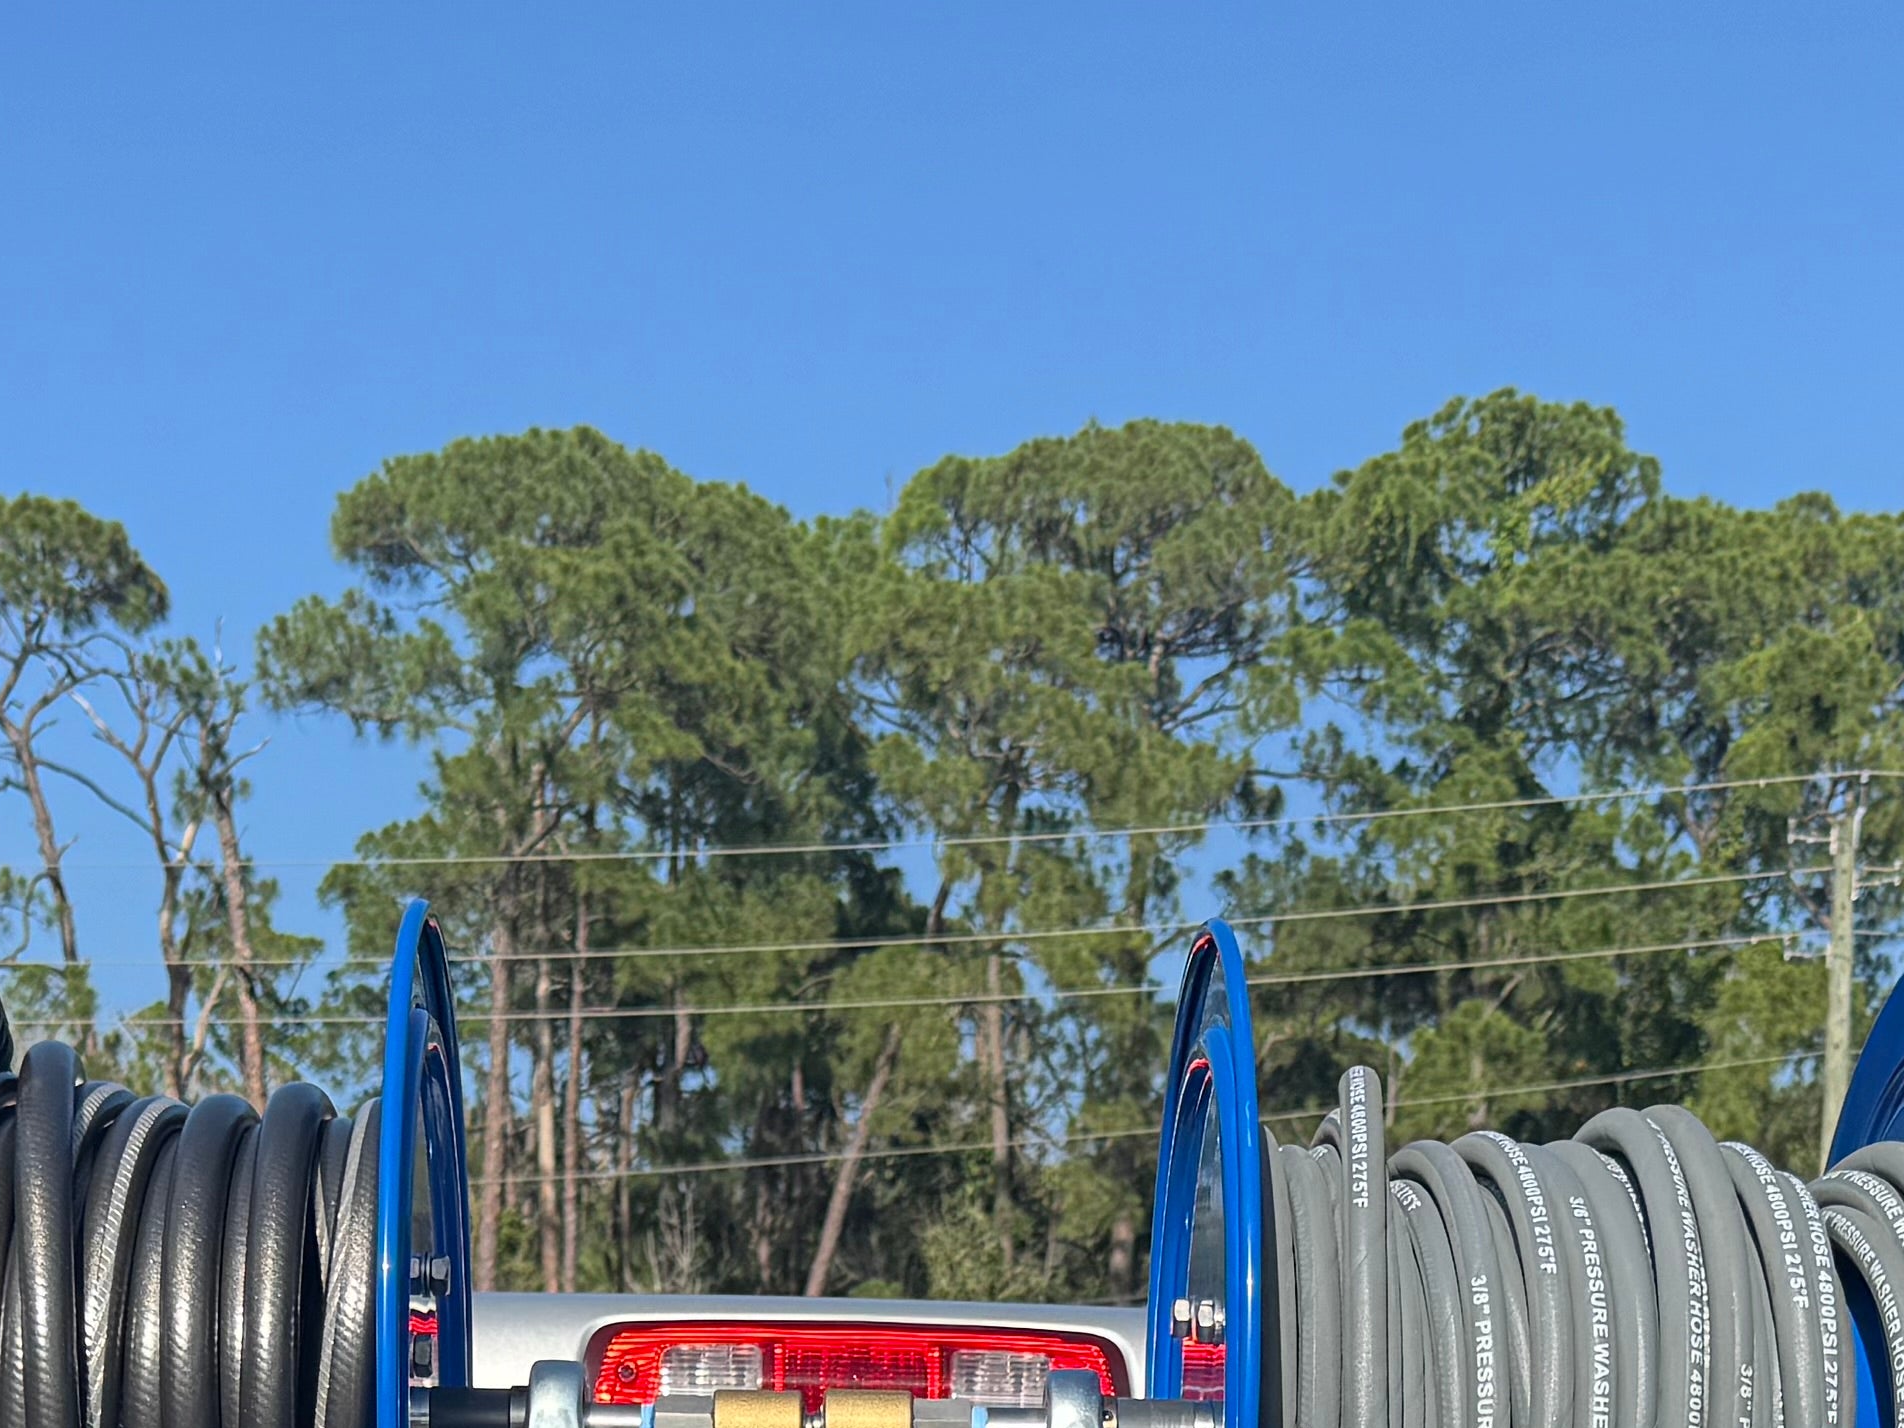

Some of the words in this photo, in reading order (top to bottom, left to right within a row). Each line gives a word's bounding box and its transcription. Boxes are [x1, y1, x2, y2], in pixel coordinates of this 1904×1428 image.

[1352, 1161, 1369, 1209] 275°F
[1534, 1224, 1558, 1275] 275°F
[1807, 1220, 1831, 1268] HOSE
[1472, 1275, 1490, 1314] 3/8"
[1578, 1228, 1610, 1339] PRESSURE
[1785, 1253, 1809, 1309] 275°F
[1869, 1259, 1901, 1337] WASHER
[1690, 1300, 1703, 1366] HOSE
[1818, 1271, 1837, 1355] 4800PSI
[1740, 1364, 1753, 1411] 3/8"
